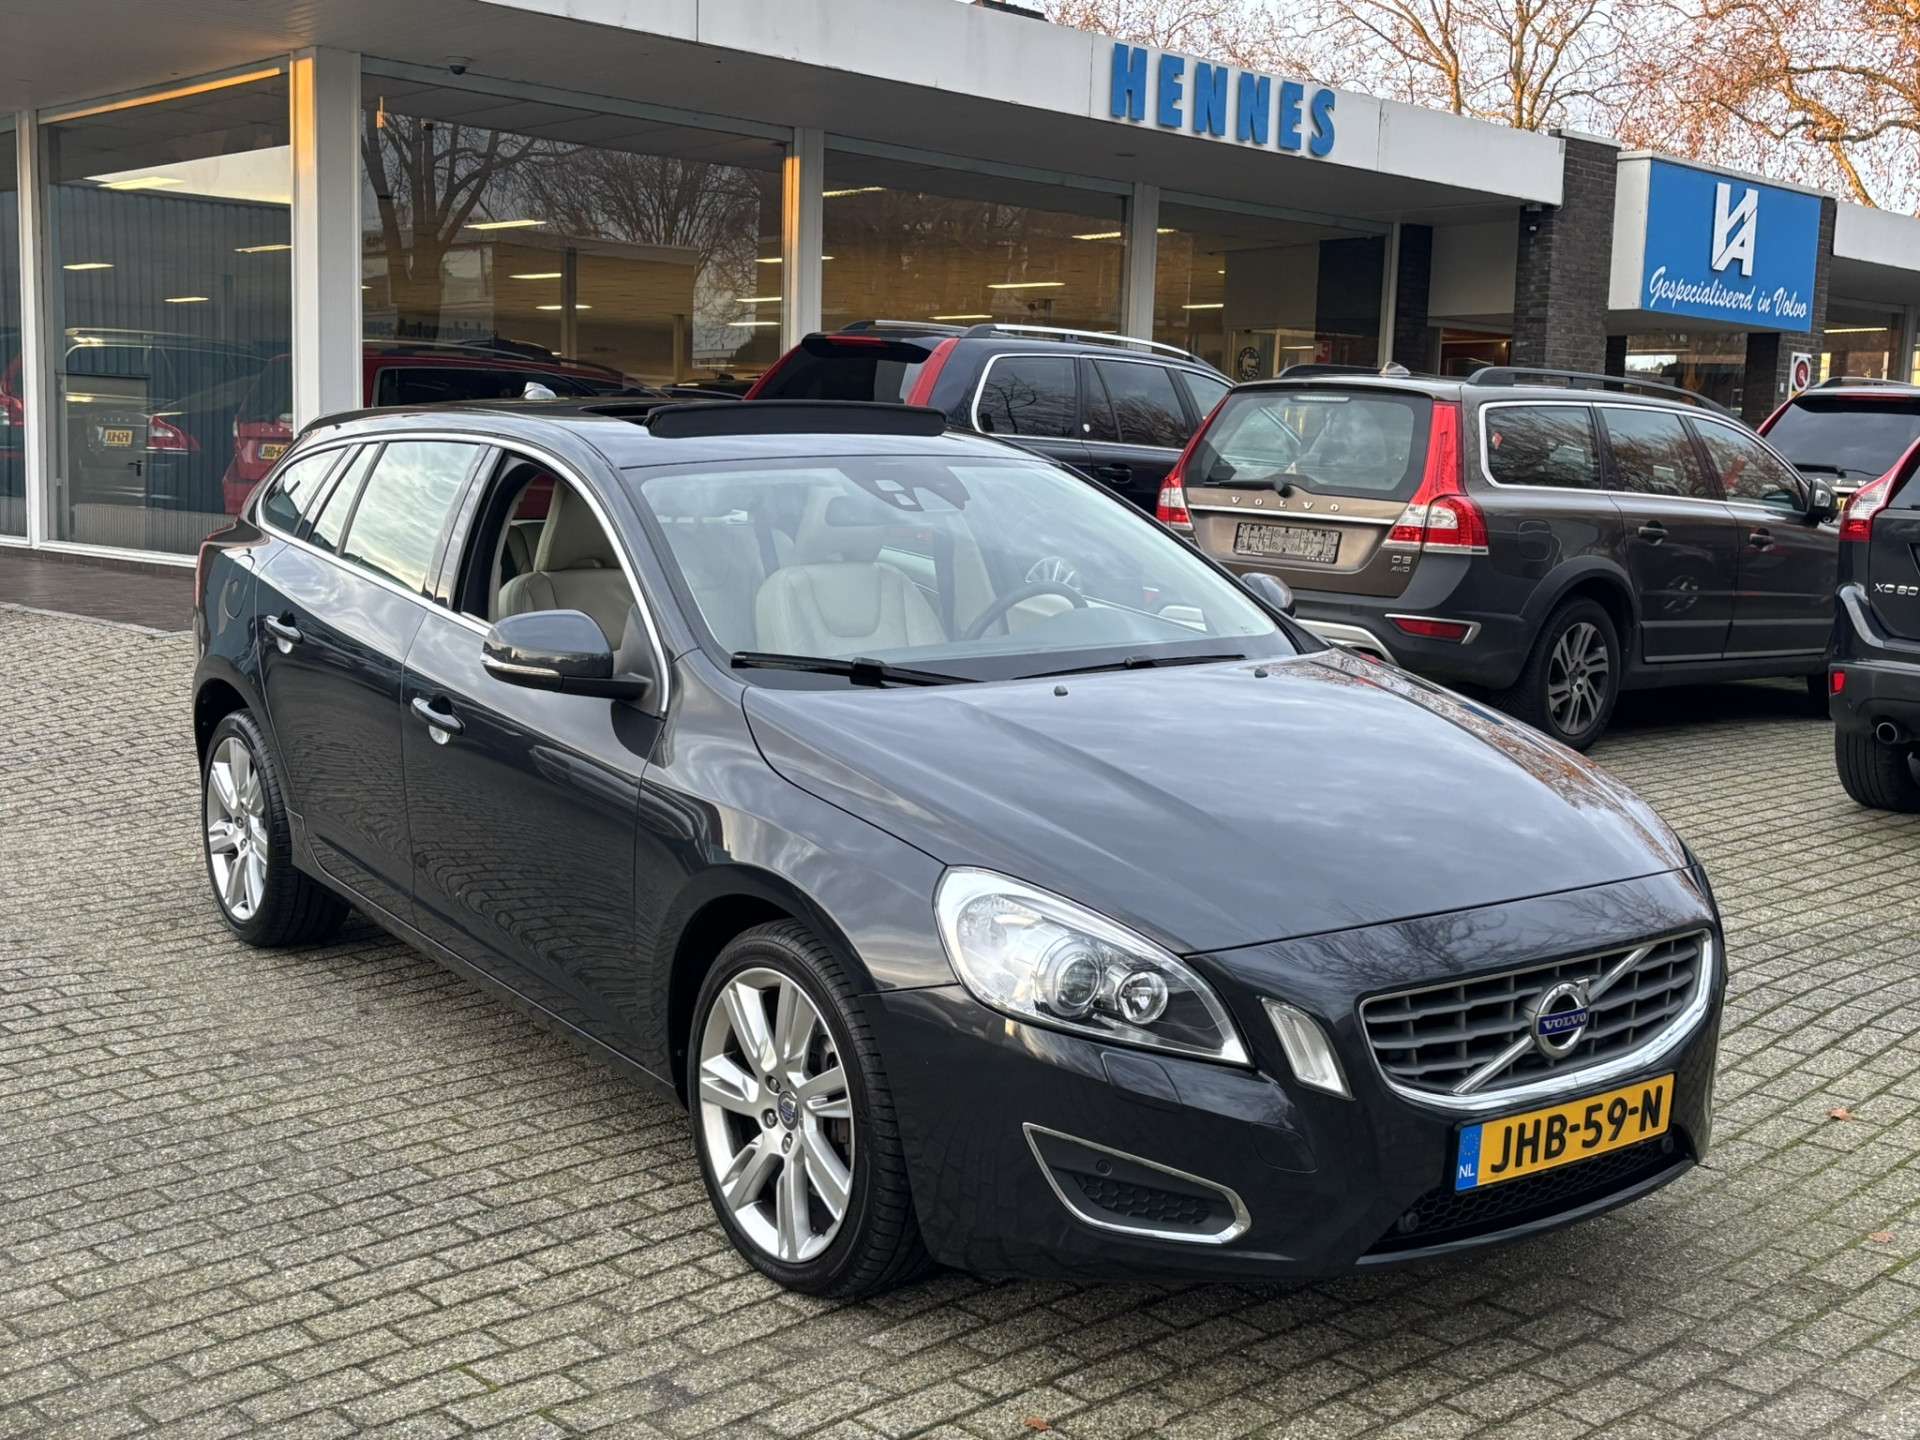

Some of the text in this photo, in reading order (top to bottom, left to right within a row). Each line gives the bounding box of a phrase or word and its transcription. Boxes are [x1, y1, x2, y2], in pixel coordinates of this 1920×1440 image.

[1110, 42, 1336, 157] HENNES
[1649, 265, 1807, 318] Gespecialiseerd in Volvo
[1231, 495, 1340, 512] VOLVO
[1543, 1012, 1587, 1030] VOLVO
[1490, 1085, 1664, 1174] JHB-59-N
[1458, 1163, 1476, 1180] NL
